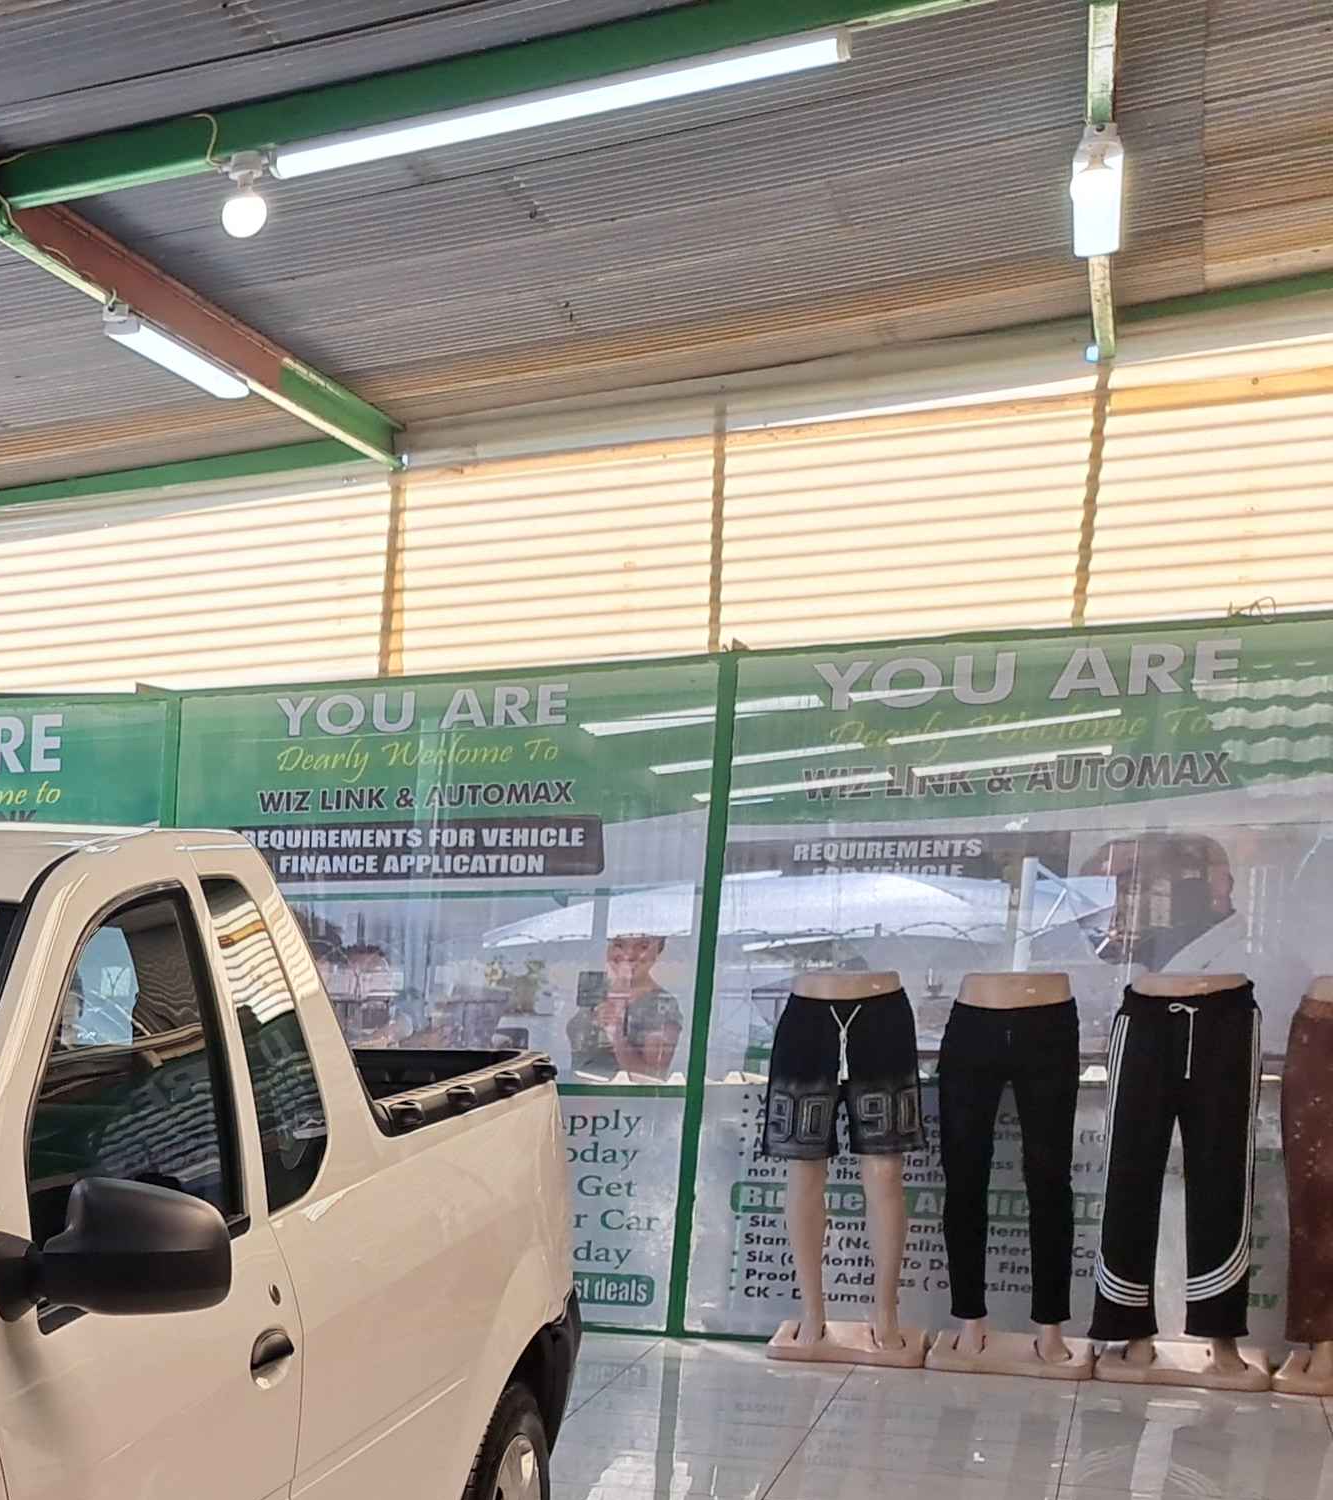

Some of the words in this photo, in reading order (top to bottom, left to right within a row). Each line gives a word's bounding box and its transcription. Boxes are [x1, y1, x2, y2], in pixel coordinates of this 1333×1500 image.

[814, 650, 1018, 711] YOU
[1049, 637, 1242, 699] ARE
[276, 690, 416, 737] YOU
[440, 683, 569, 728] ARE
[277, 737, 370, 783] Dearly
[524, 738, 560, 763] To
[1025, 751, 1232, 792] AUTOMAX
[36, 784, 62, 805] to
[258, 790, 311, 813] WIZ
[320, 786, 387, 811] LINK
[395, 787, 416, 809] &
[425, 781, 575, 807] AUTOMAX
[428, 828, 479, 847] FOR
[482, 827, 585, 847] VEHICLE
[793, 839, 983, 861] REQUIREMENTS
[279, 854, 378, 874] FINANCE
[382, 853, 544, 874] APPLICATION
[561, 1109, 642, 1139] pply
[577, 1175, 638, 1198] Get
[600, 1209, 660, 1231] Car
[749, 1215, 777, 1228] Six
[746, 1251, 774, 1263] Six
[594, 1279, 648, 1303] deals
